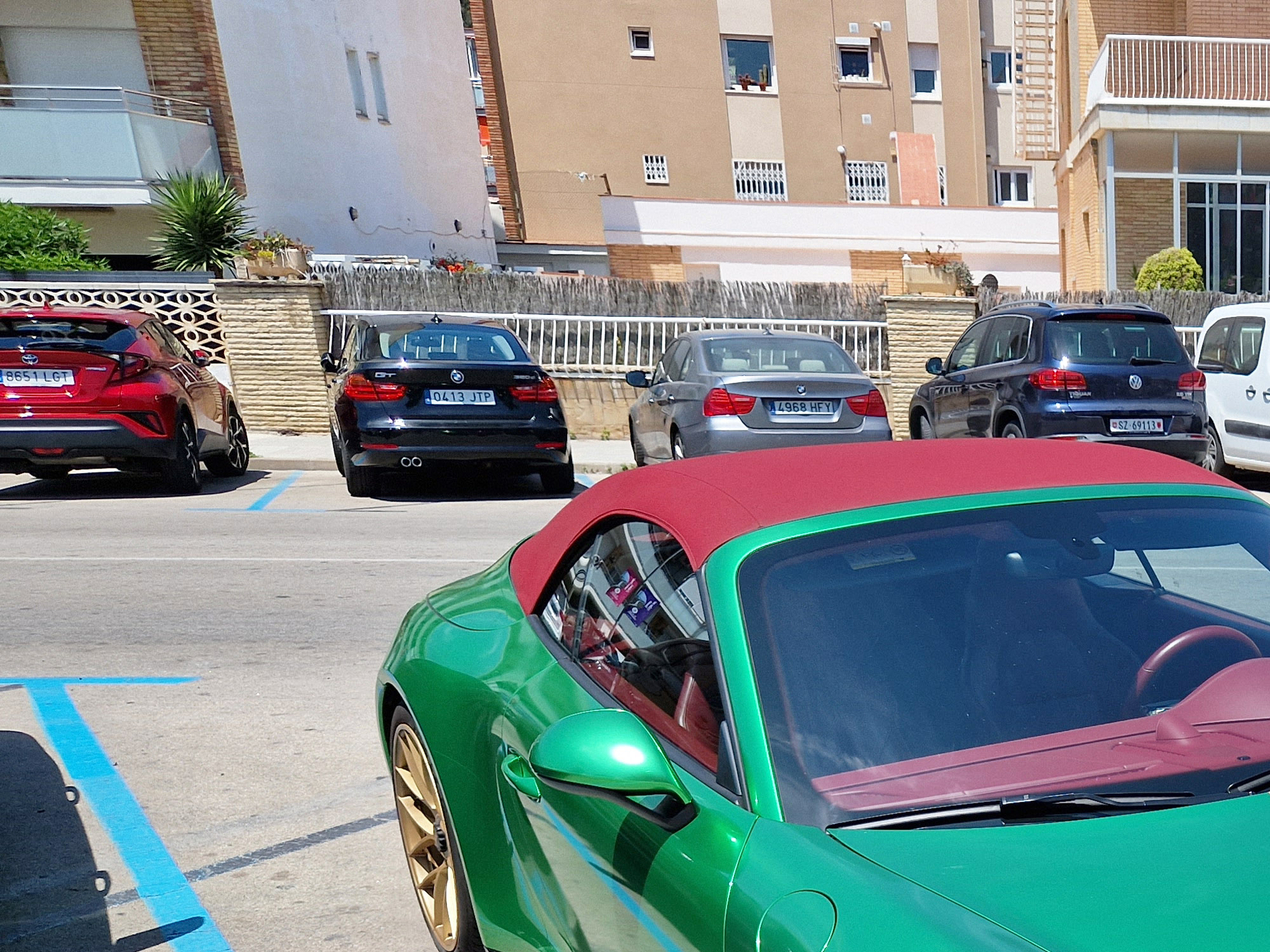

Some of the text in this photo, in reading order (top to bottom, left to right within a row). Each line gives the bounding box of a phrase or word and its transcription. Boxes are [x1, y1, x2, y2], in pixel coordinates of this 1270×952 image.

[6, 371, 68, 382] 8651 LGT
[433, 392, 491, 403] 0413 JTP
[778, 402, 831, 412] 4968 HFY
[1132, 421, 1156, 430] 69113
